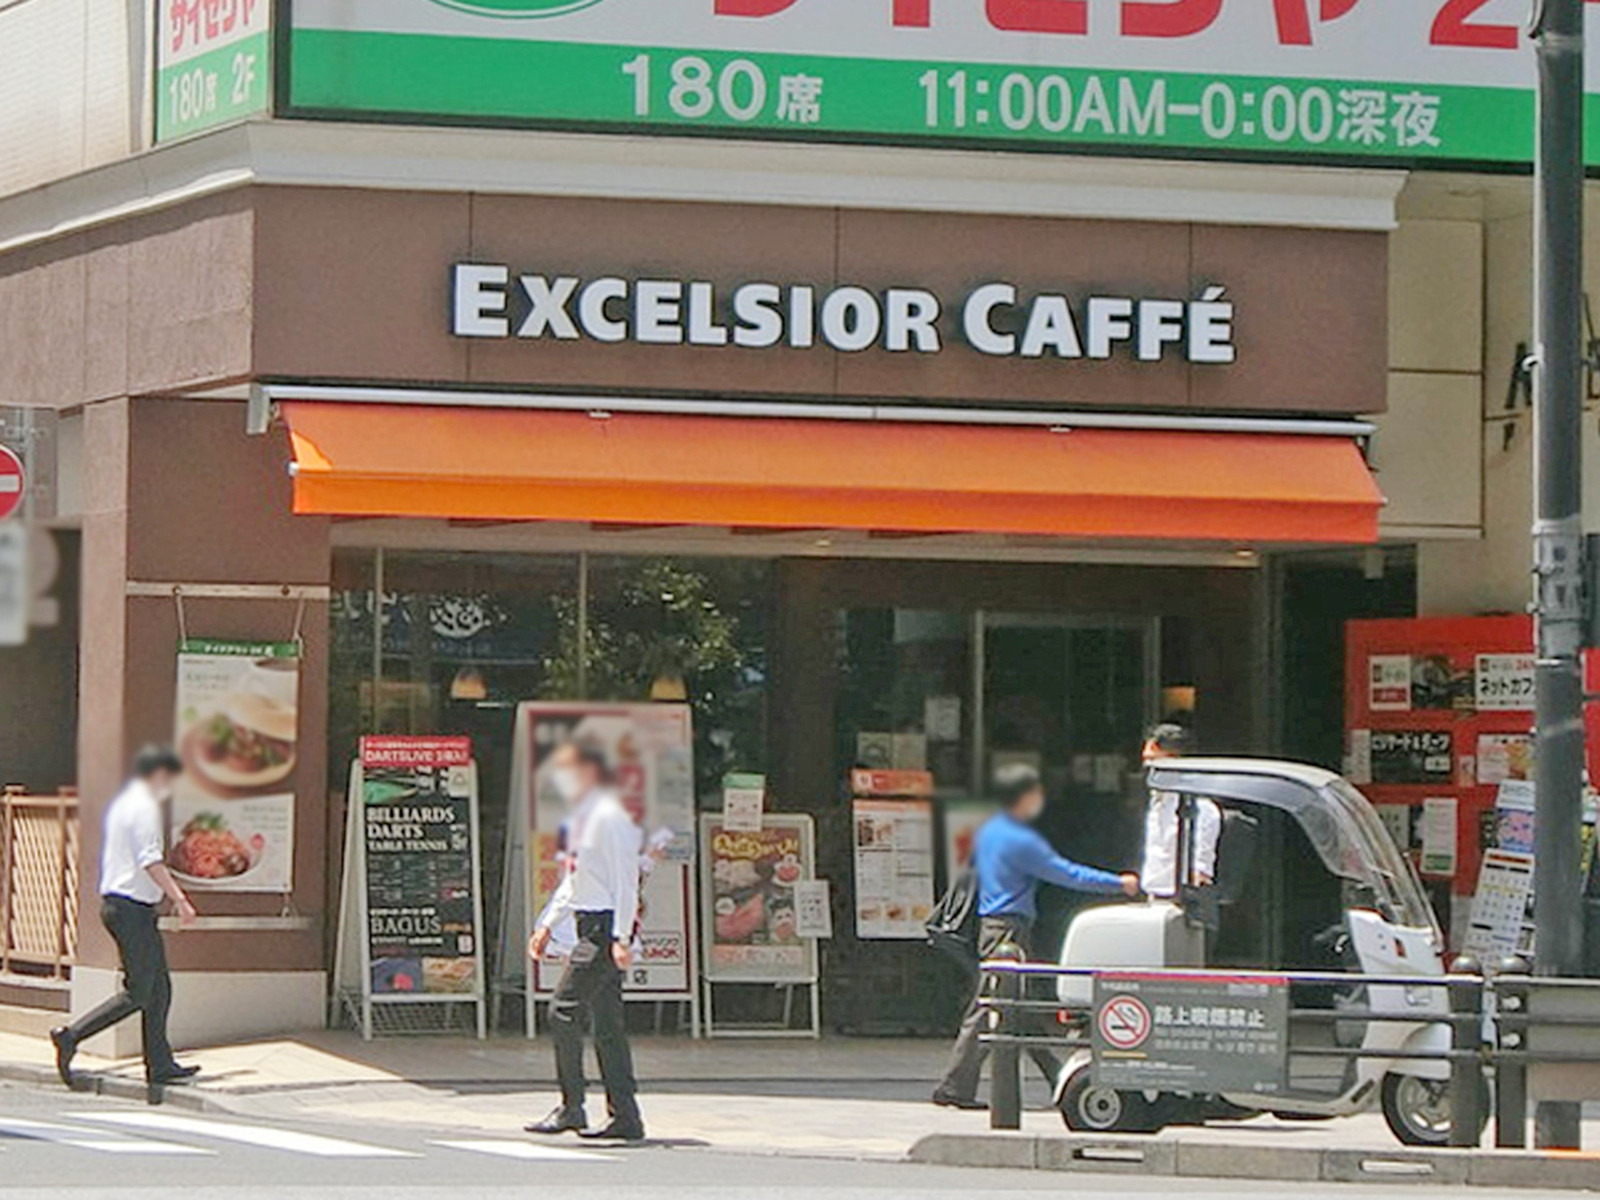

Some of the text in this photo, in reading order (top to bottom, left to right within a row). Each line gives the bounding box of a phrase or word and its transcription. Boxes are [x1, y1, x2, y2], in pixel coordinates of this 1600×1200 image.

[231, 52, 257, 104] 2F
[621, 54, 823, 125] 180席
[366, 806, 455, 823] BILLIARDS
[366, 823, 424, 839] DARTS
